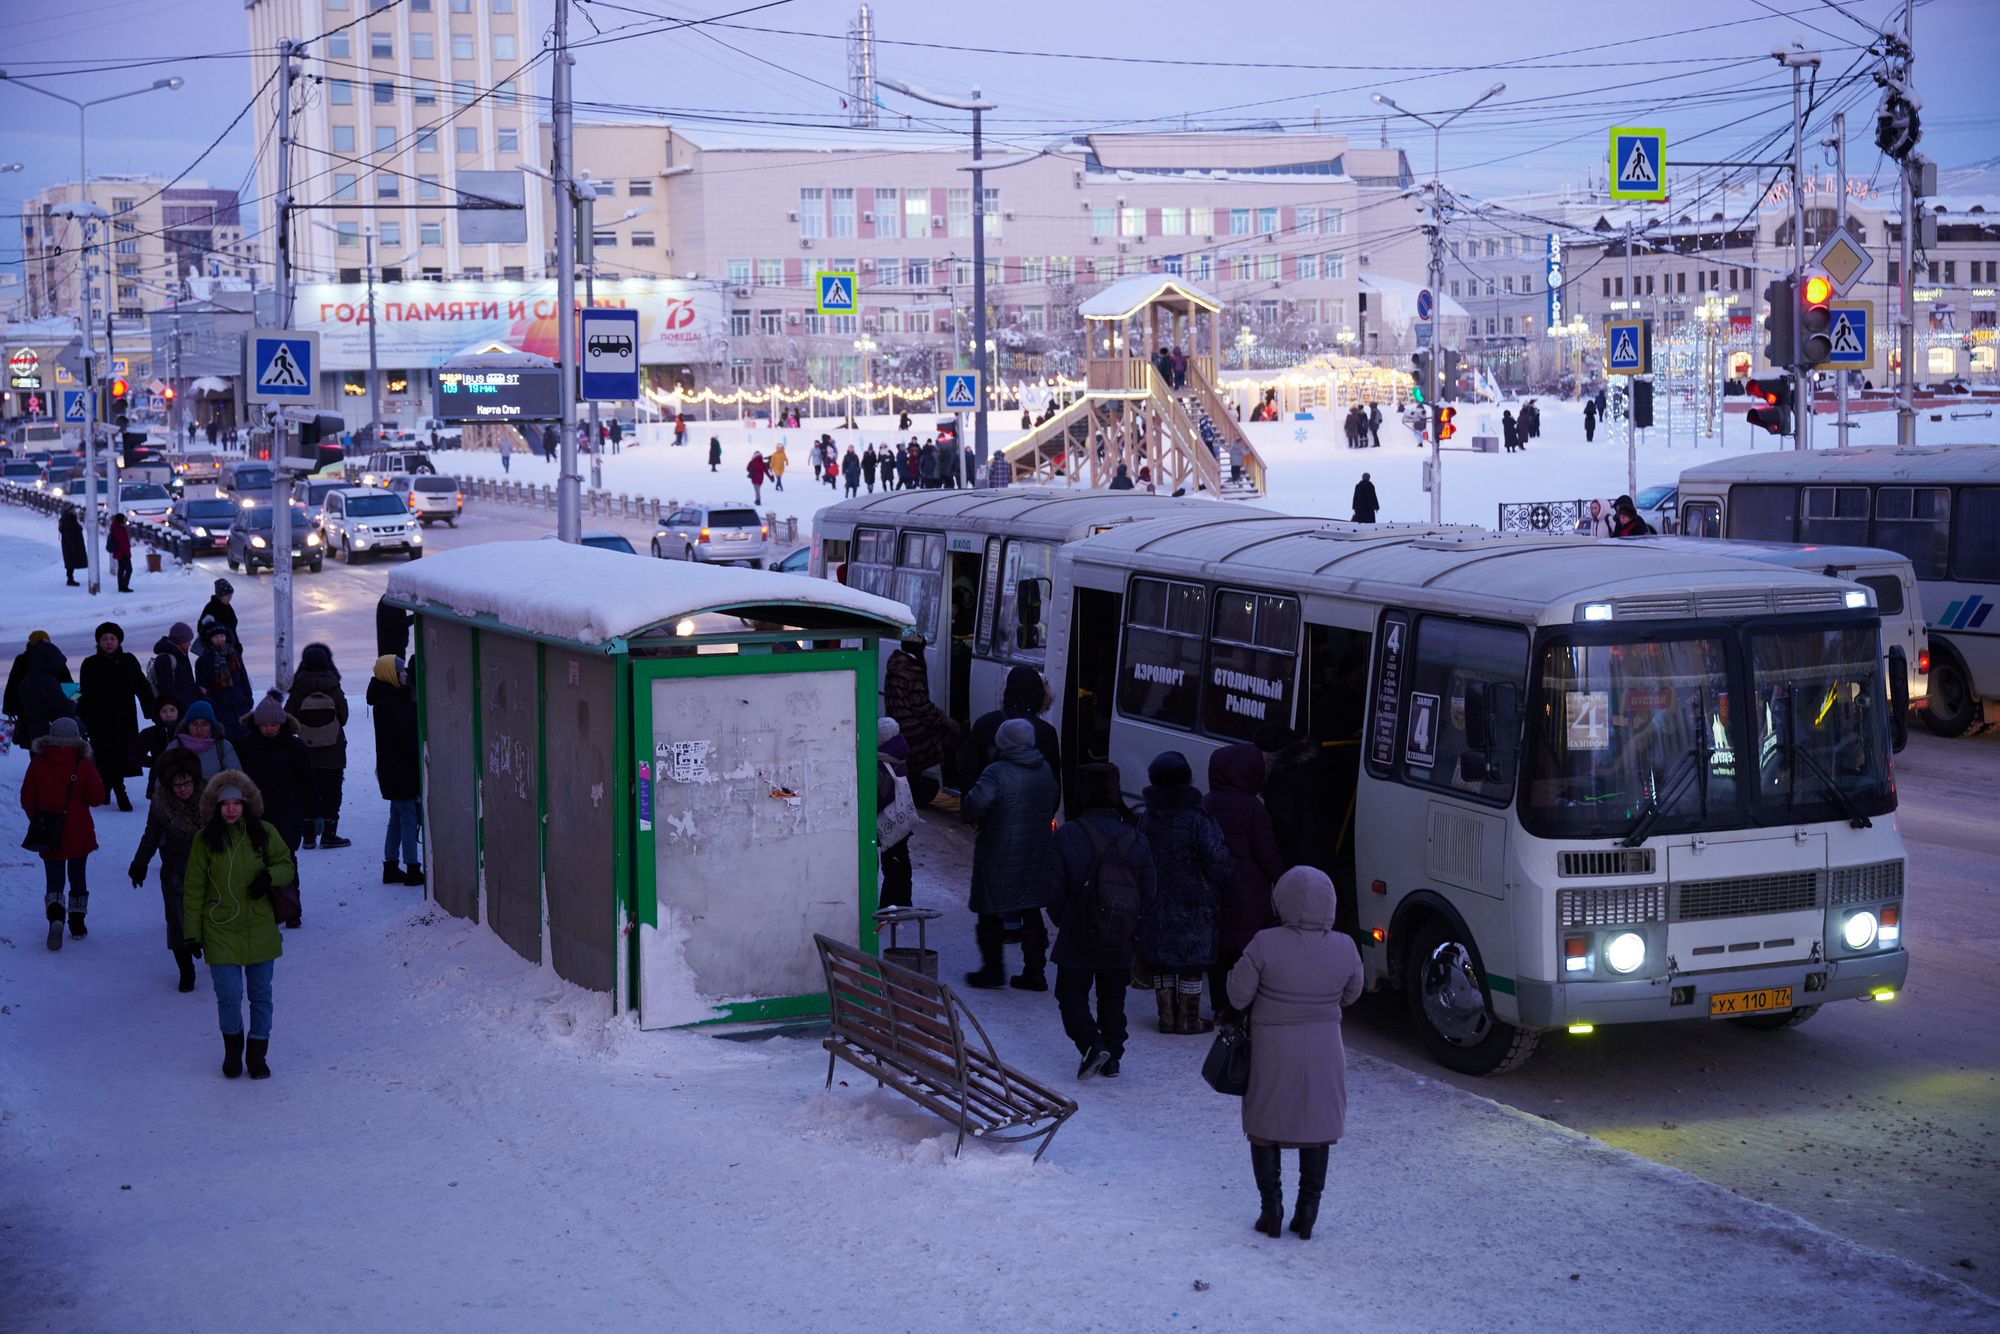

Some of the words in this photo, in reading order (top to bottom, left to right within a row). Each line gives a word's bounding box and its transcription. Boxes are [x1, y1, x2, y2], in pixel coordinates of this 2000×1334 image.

[1826, 175, 1869, 199] ПАЗА
[320, 303, 376, 326] ГОД
[385, 301, 498, 321] ПАМЯТИ
[508, 300, 526, 320] И
[666, 296, 696, 330] 75
[443, 384, 458, 393] 109
[466, 374, 485, 383] BUS
[506, 374, 520, 383] ST
[477, 405, 501, 415] Карта
[953, 538, 972, 550] ВХОД
[1387, 624, 1400, 655] 4
[1134, 663, 1185, 687] АЭРОПОРТ
[1214, 668, 1283, 701] СТОЛИЧНЫЙ
[1225, 694, 1266, 720] РЫНОК
[1571, 700, 1604, 738] 4
[1414, 707, 1430, 753] 4
[1743, 992, 1767, 1009] 110
[1775, 990, 1787, 1001] 77
